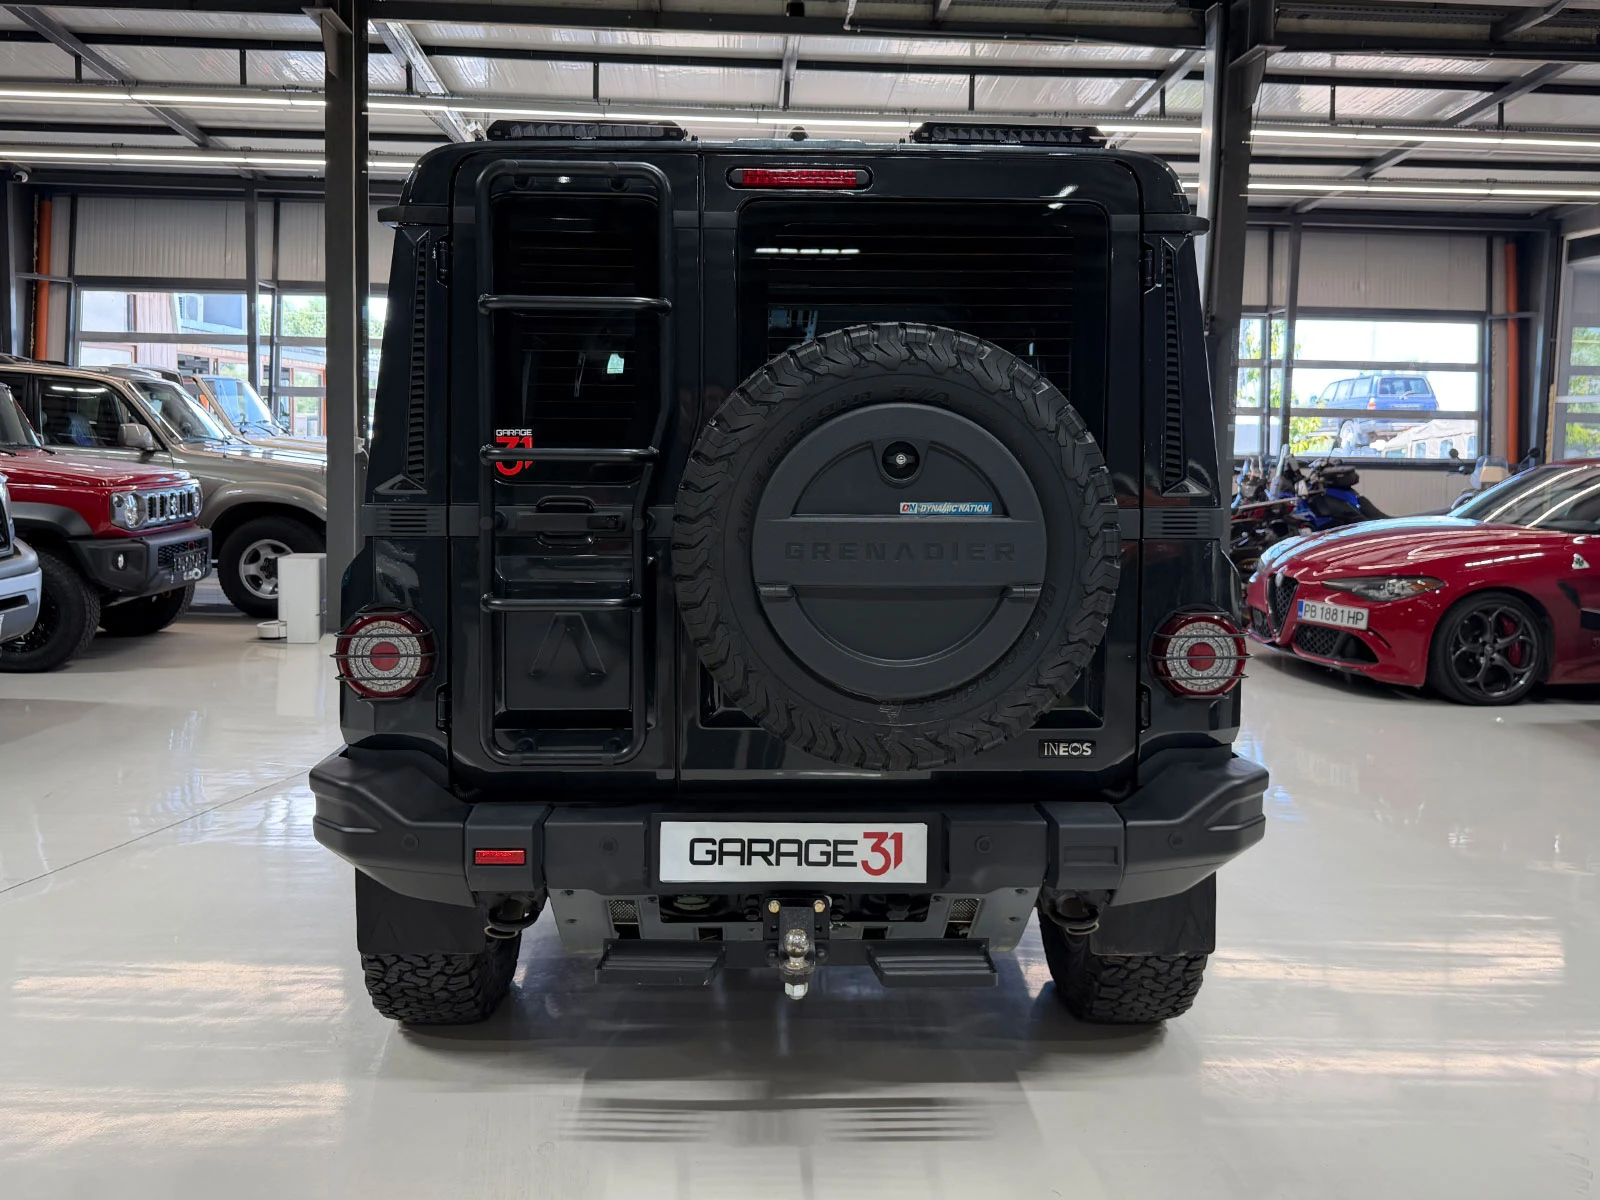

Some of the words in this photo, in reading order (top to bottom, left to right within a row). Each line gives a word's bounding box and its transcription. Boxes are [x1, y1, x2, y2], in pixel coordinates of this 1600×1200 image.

[496, 436, 533, 476] 31
[902, 503, 916, 512] DN
[920, 504, 957, 512] DYNAMIC
[959, 504, 989, 512] NATION
[785, 542, 1016, 561] GRENADIER
[1304, 604, 1316, 618] PB
[1320, 607, 1344, 623] 1881
[1347, 610, 1364, 625] HP
[1044, 742, 1092, 756] INEOS
